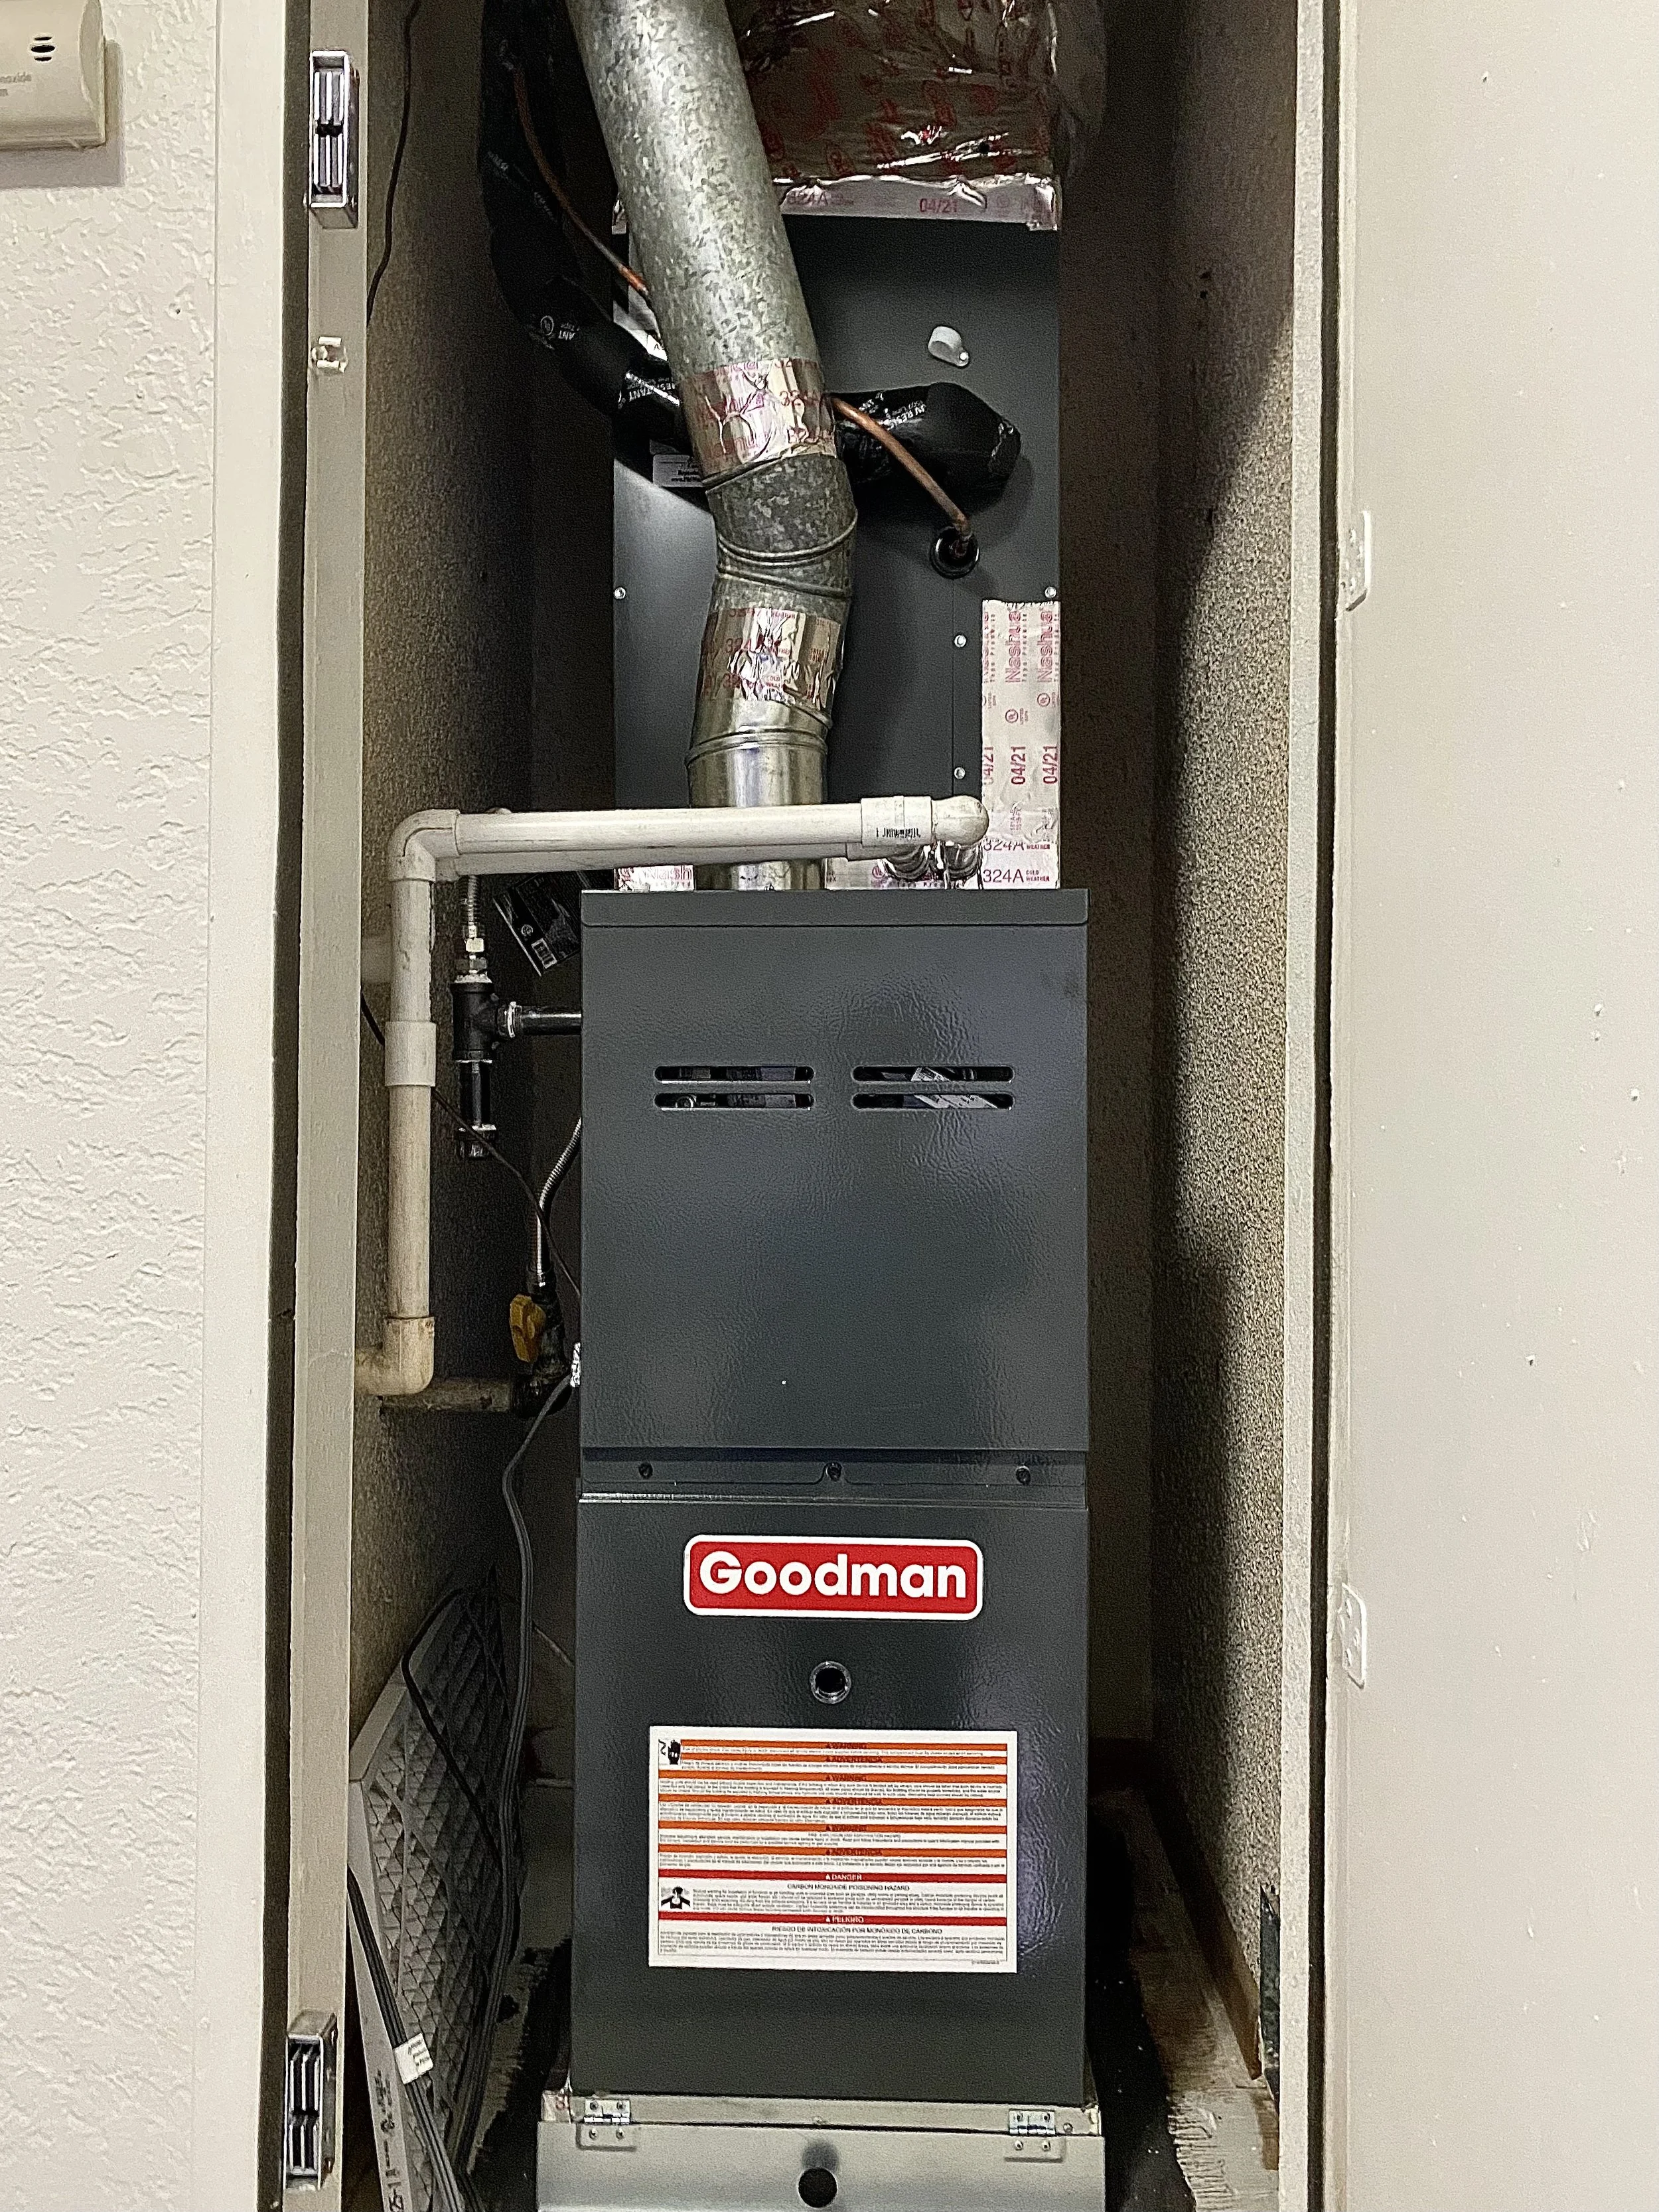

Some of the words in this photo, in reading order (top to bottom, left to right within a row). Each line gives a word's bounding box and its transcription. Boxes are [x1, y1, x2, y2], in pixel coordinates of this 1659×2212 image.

[919, 198, 958, 213] 04/21
[1005, 611, 1021, 683] Nashua
[1037, 611, 1053, 683] Nashua
[1011, 746, 1026, 785] 04/21
[1043, 745, 1058, 784] 04/21
[644, 865, 693, 880] Nash
[983, 869, 1025, 883] 324A
[699, 1550, 966, 1598] Goodman
